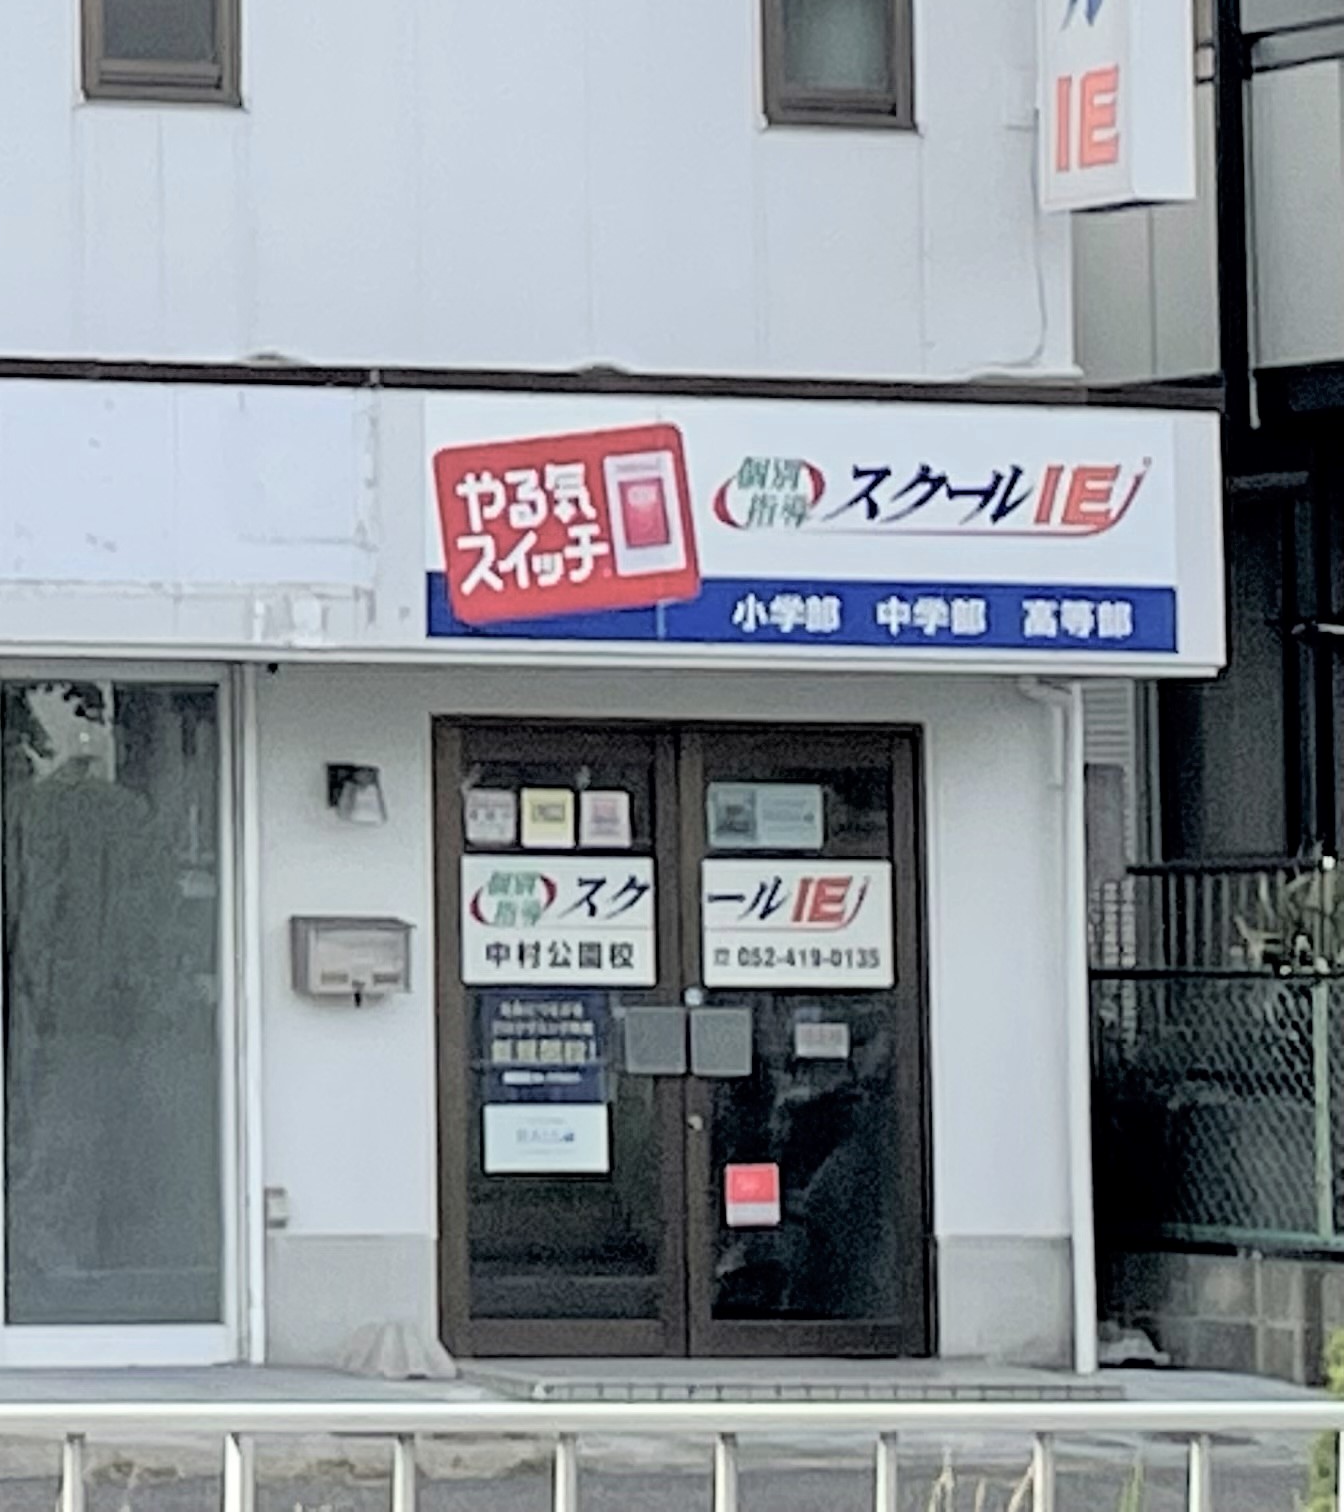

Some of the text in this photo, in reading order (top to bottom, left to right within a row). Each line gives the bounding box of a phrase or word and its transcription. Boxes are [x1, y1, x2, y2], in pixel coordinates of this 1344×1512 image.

[456, 462, 596, 533] やる気
[456, 524, 610, 596] スイッチ
[732, 593, 842, 633] 小学部
[876, 595, 986, 637] 中学部
[485, 940, 634, 969] 中村公園校
